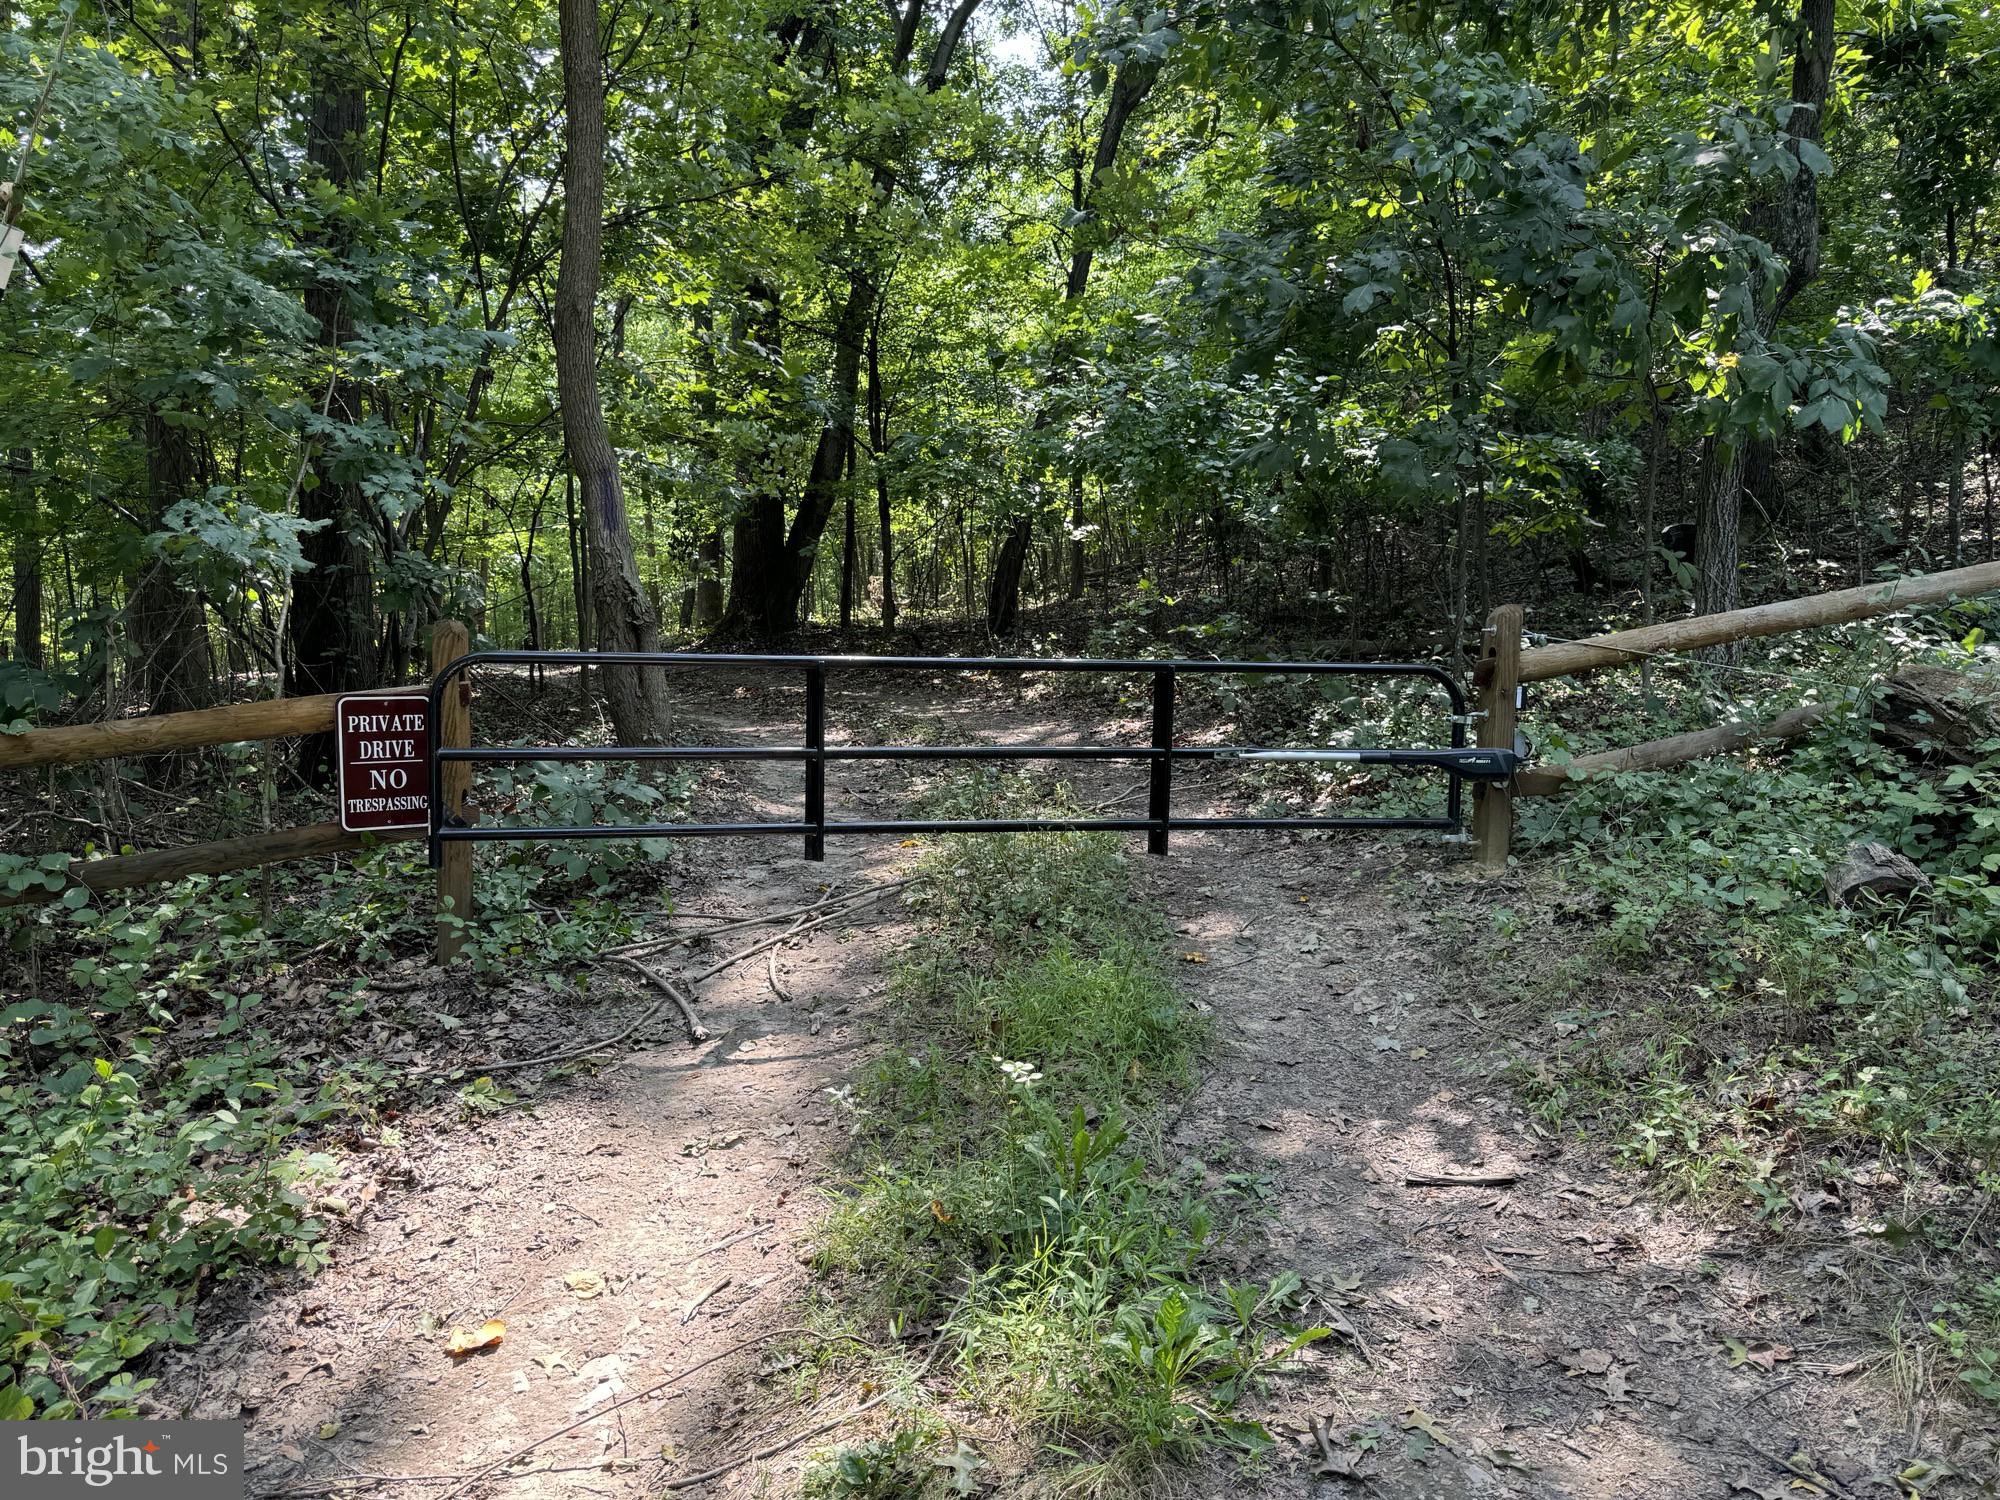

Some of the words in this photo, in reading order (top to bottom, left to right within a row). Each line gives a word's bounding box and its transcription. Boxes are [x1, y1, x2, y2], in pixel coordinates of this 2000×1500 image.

[347, 714, 425, 733] PRIVATE
[359, 739, 415, 759] DRIVE
[369, 768, 408, 790] NO
[347, 795, 428, 813] TRESPASSING
